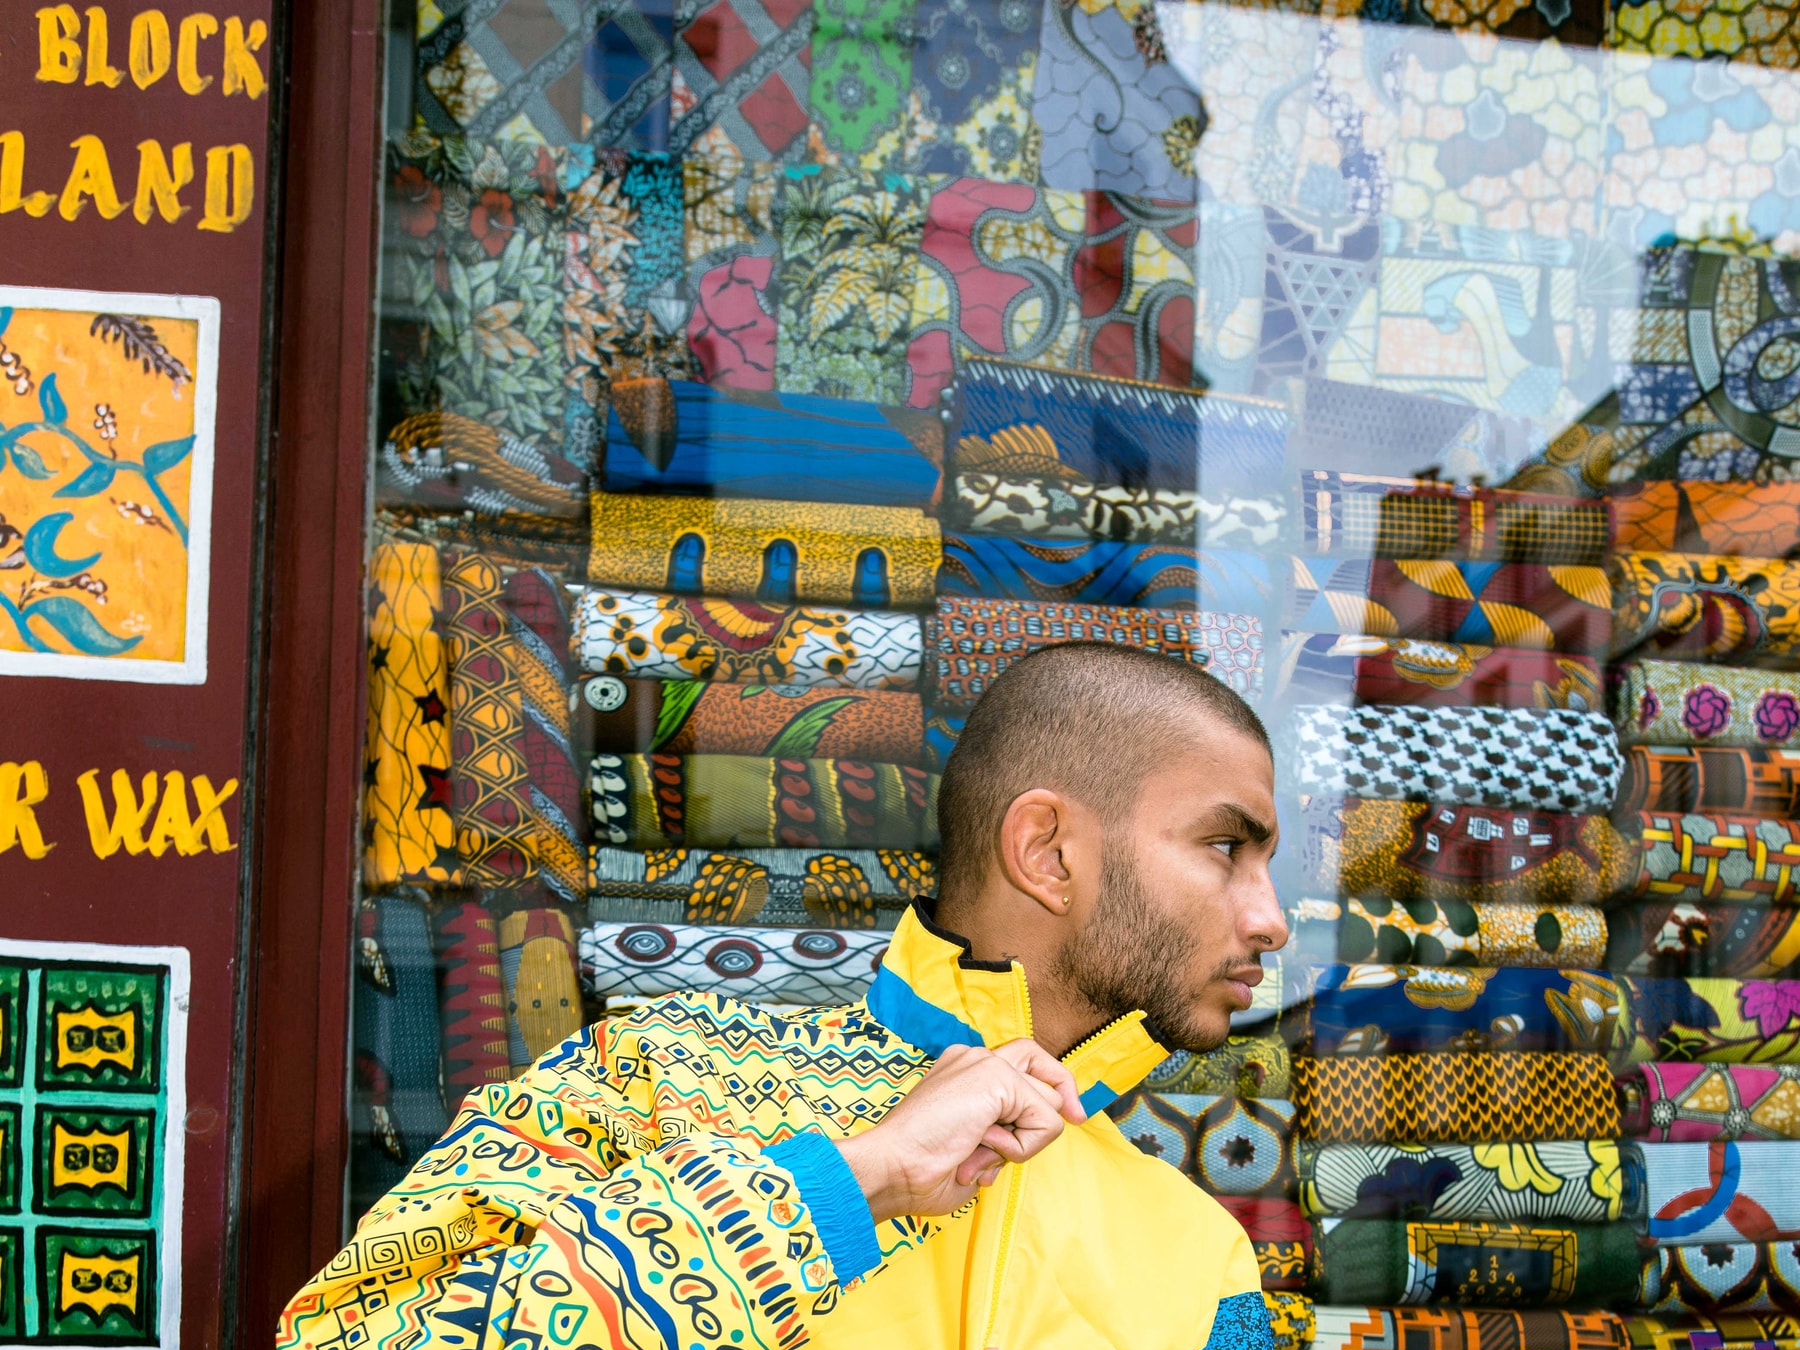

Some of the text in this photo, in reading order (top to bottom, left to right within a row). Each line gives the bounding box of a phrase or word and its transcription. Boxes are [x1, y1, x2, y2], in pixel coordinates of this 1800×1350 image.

[35, 3, 269, 100] BLOCK
[0, 130, 254, 233] LAND
[76, 768, 239, 860] WAX
[1468, 1268, 1516, 1285] 2 3 4
[1489, 1254, 1499, 1269] 1
